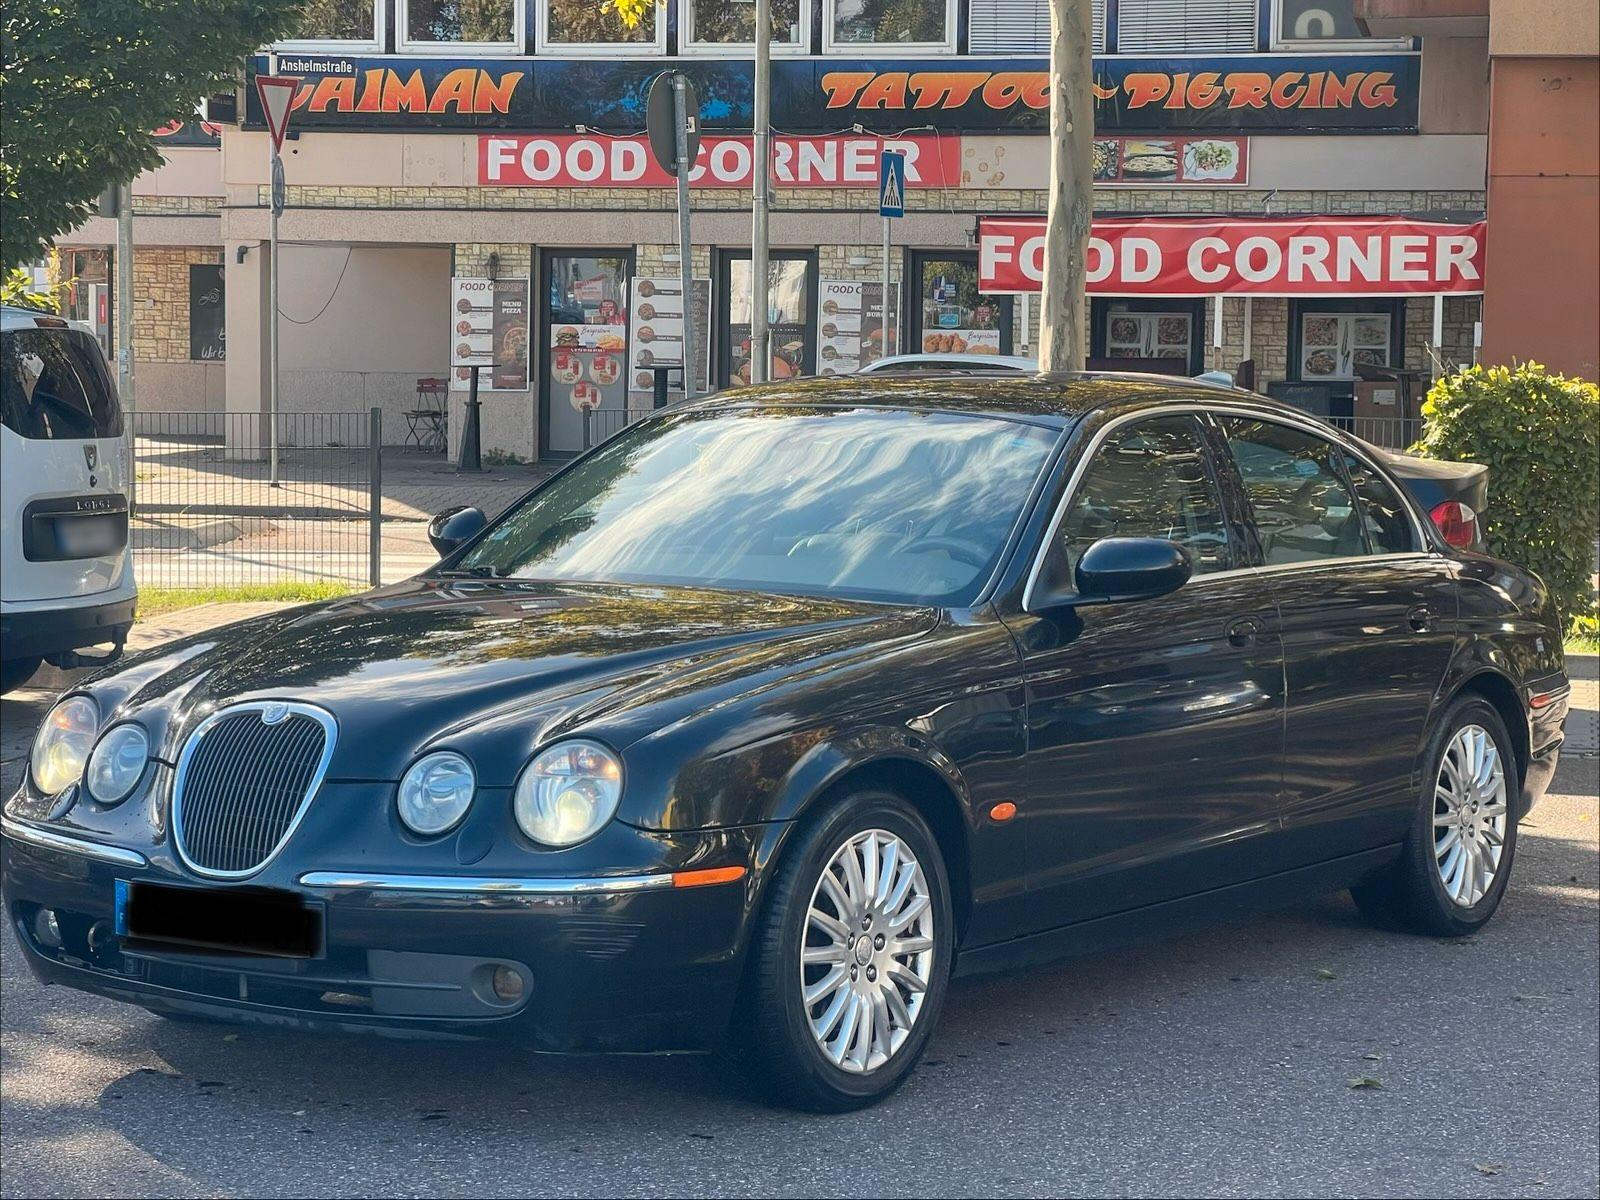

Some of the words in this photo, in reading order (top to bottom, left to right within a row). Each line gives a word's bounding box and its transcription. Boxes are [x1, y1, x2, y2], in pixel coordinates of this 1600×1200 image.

[280, 59, 353, 73] Anshelmstraße
[1123, 71, 1398, 109] PIERCING
[487, 139, 648, 182] FOOD
[980, 235, 1163, 284] FOOD
[1186, 234, 1480, 283] CORNER
[460, 282, 486, 292] FOOD
[827, 285, 854, 295] FOOD
[866, 311, 895, 319] BURR
